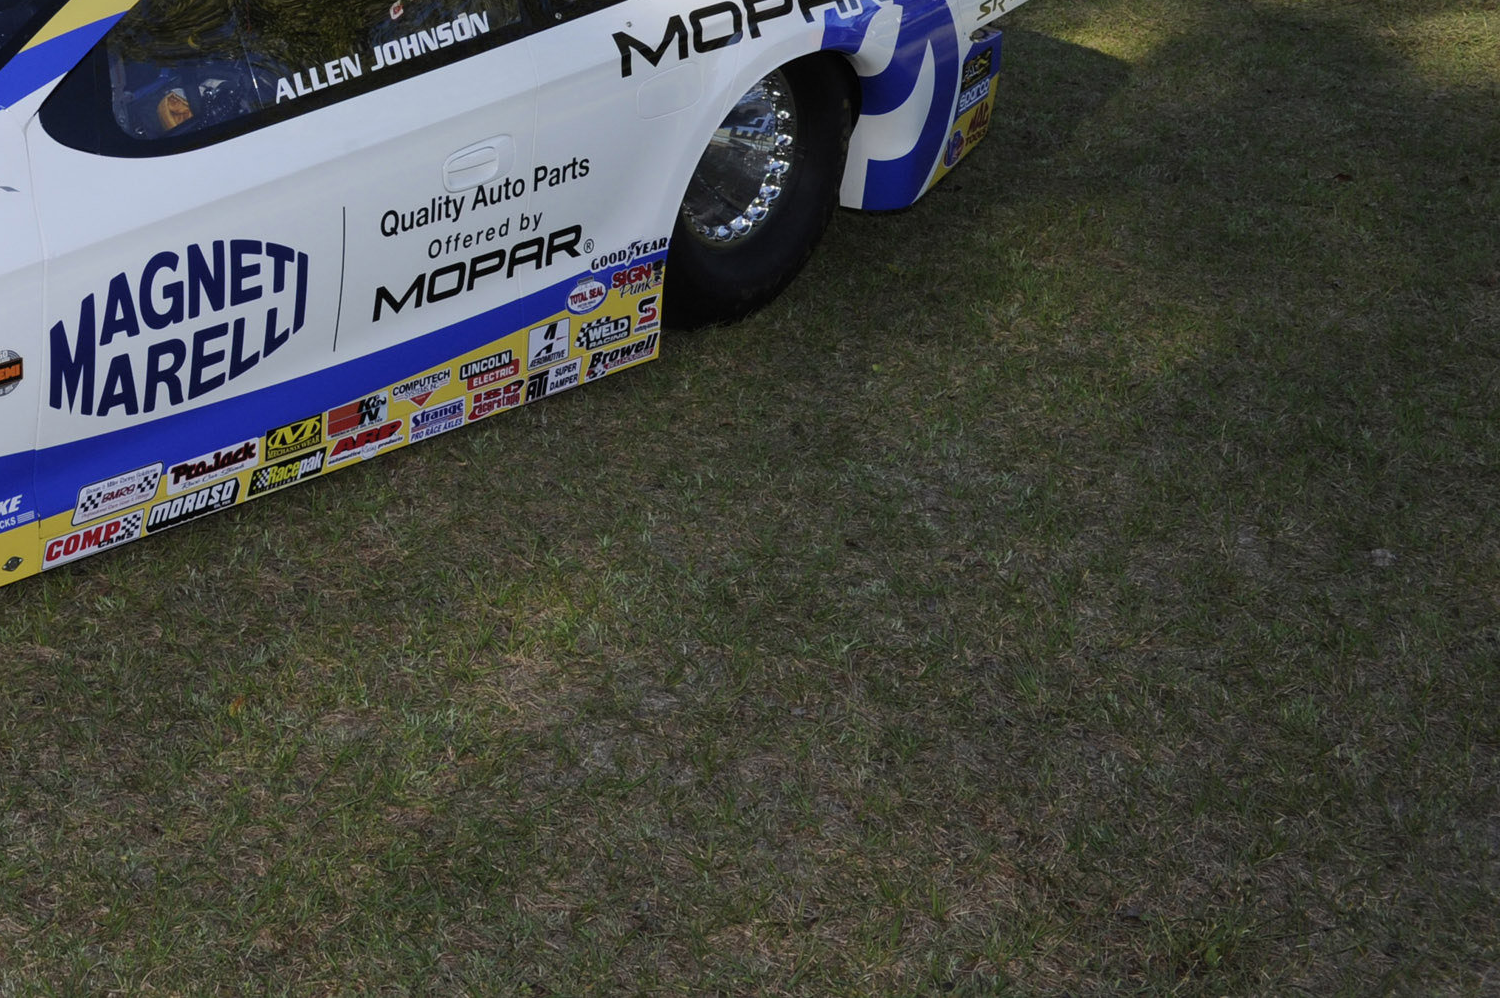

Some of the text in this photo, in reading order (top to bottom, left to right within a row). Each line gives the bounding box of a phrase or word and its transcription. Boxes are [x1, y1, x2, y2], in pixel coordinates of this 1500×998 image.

[275, 10, 491, 105] ALLEN JOHNSON
[959, 78, 992, 108] sparco
[380, 155, 591, 238] Quality Auto Parts
[427, 210, 544, 260] Offered by
[612, 262, 652, 290] SIGN
[569, 291, 589, 306] TOTAL
[588, 286, 604, 299] SEAL
[49, 238, 310, 398] MAGNETI
[588, 317, 630, 340] WELD
[49, 280, 310, 417] MARELLI
[589, 331, 629, 349] RACING
[589, 332, 660, 370] Browell
[461, 351, 511, 378] LINCOLN
[530, 349, 566, 368] AEROMOTIVE
[554, 361, 577, 378] SUPER
[392, 369, 451, 396] COMPUTECH
[472, 365, 515, 387] ELECTRIC
[526, 369, 550, 402] ATI
[550, 374, 579, 392] DAMPER
[411, 401, 465, 428] Strange
[329, 420, 403, 457] ARP
[410, 417, 463, 442] PRO RACE AXLES
[266, 451, 325, 484] Racepak
[147, 479, 237, 527] MOROSO
[45, 520, 122, 562] COMP
